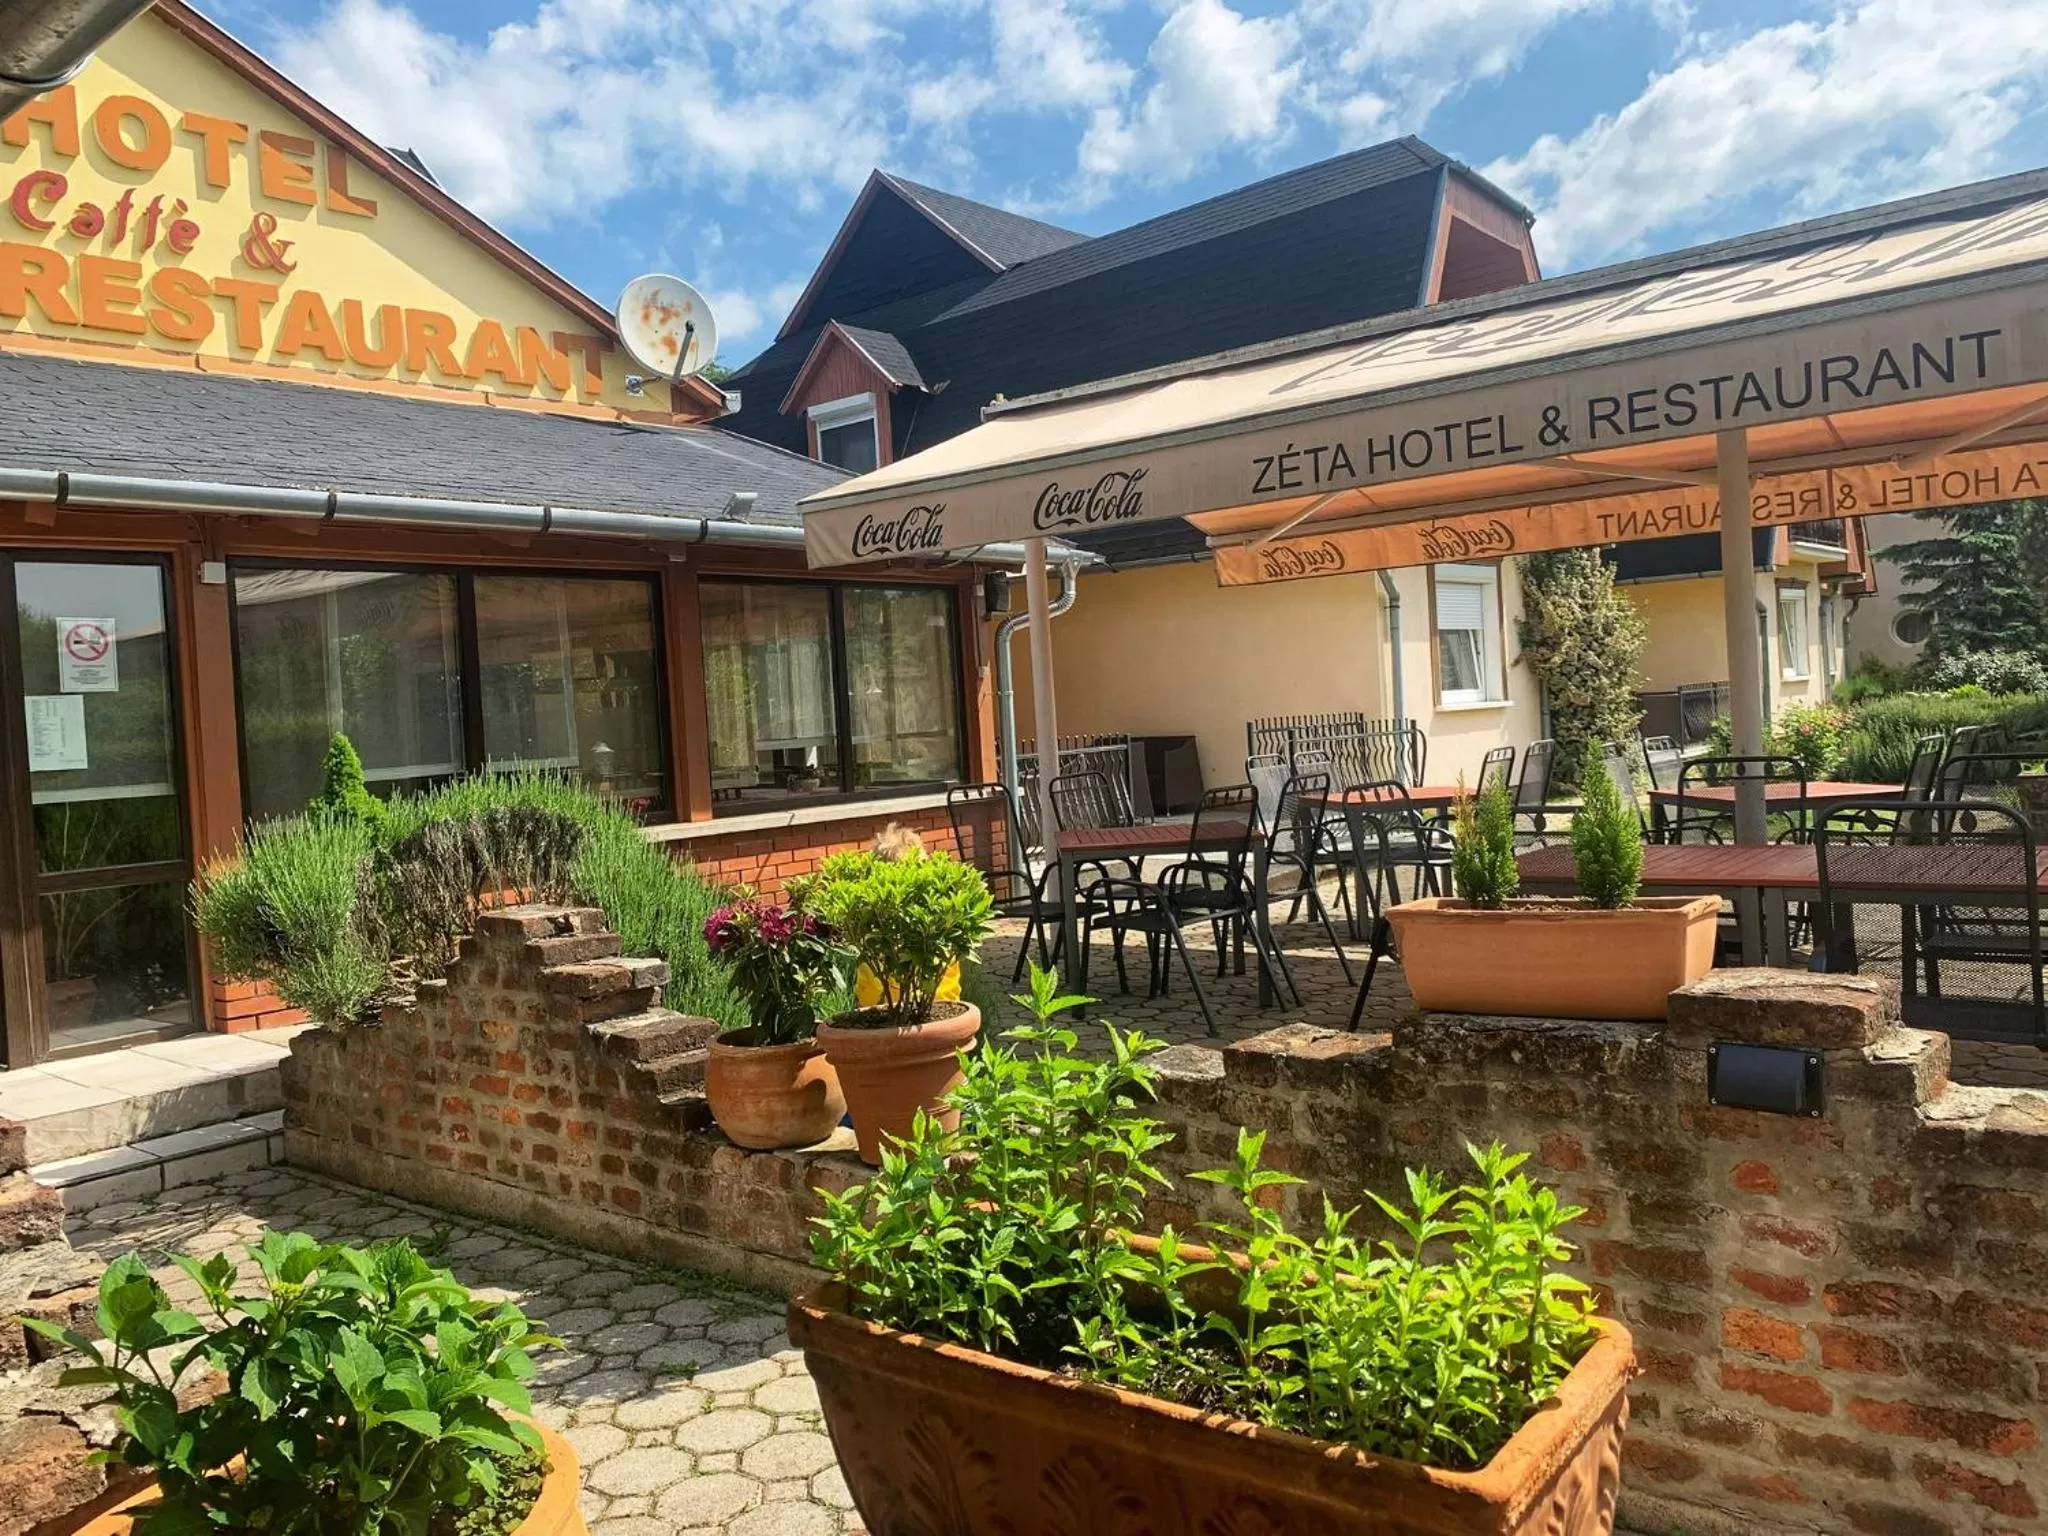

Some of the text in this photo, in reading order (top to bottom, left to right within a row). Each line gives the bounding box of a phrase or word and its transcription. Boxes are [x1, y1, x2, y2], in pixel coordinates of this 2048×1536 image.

[2, 85, 378, 217] HOTEL
[10, 170, 297, 274] Caffè &
[0, 241, 615, 395] RESTAURANT
[1251, 328, 2003, 495] ZÉTA HOTEL & RESTAURANT
[851, 503, 947, 558] Coca-Cola
[1033, 467, 1150, 531] Coca-Cola
